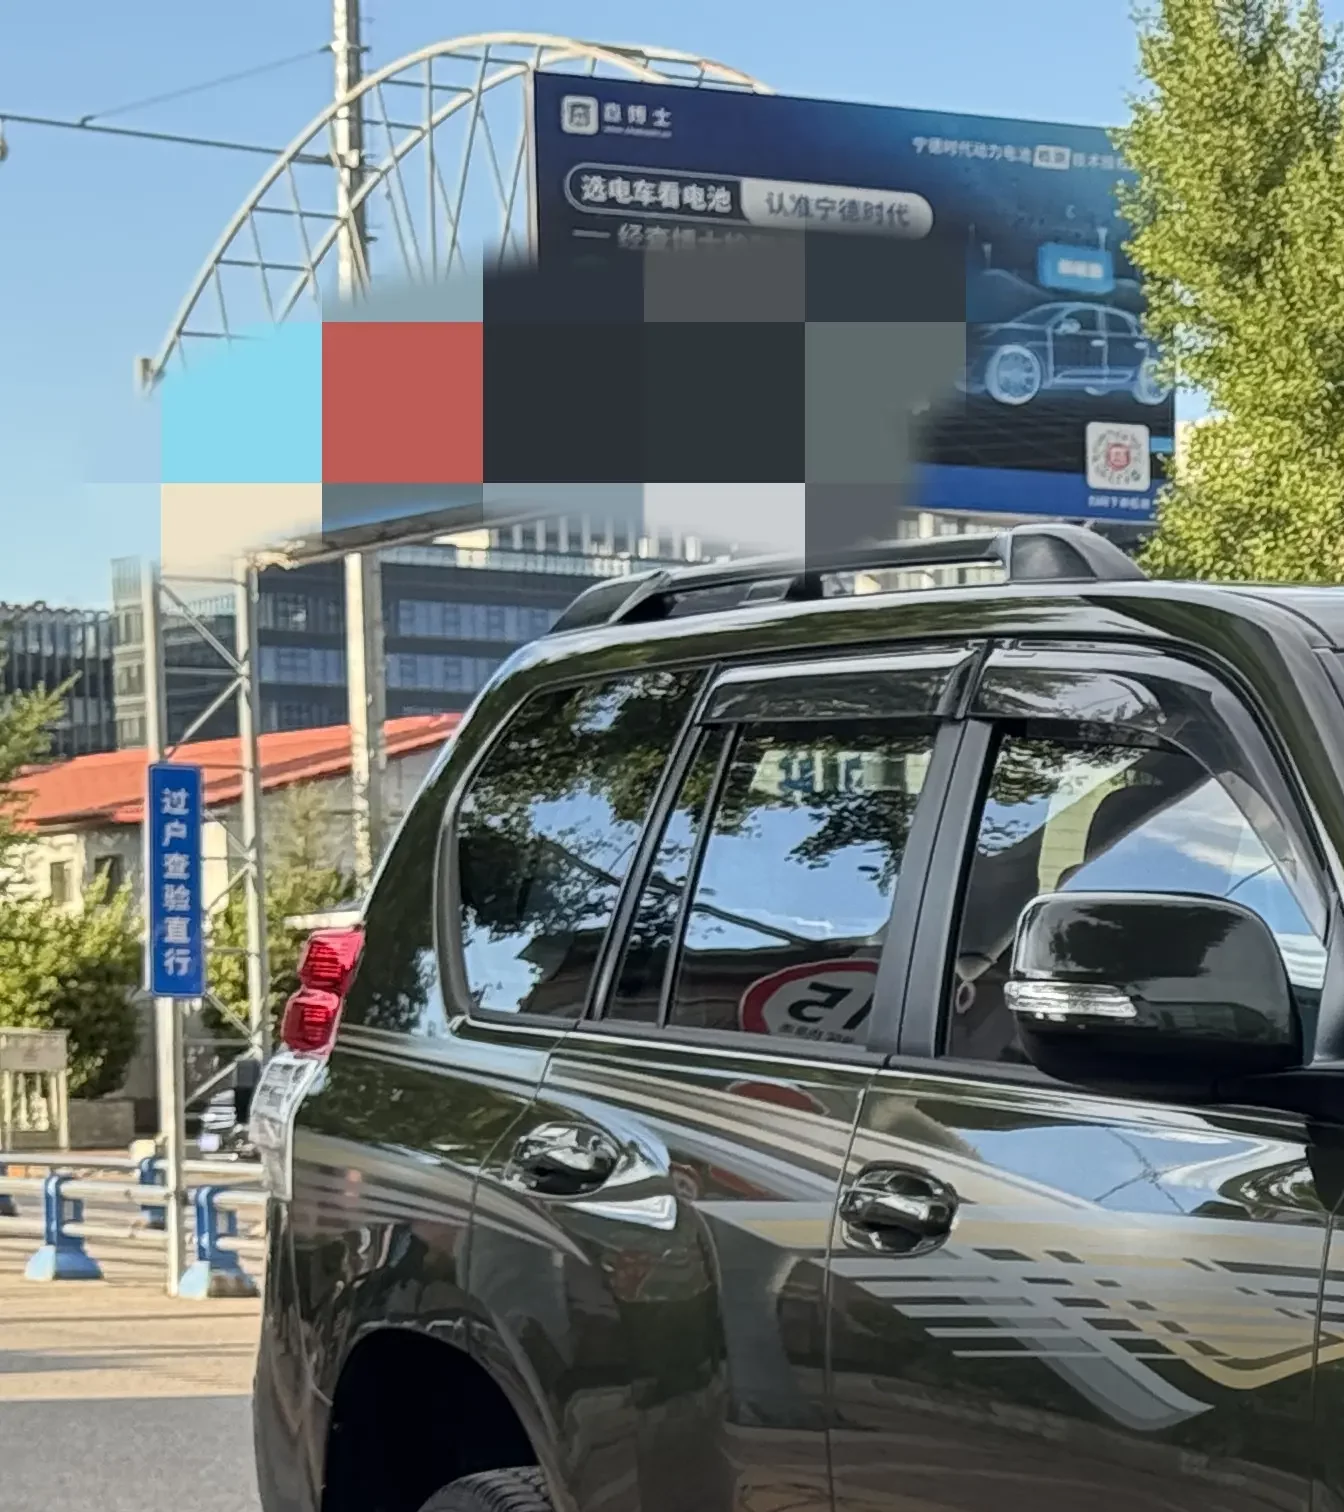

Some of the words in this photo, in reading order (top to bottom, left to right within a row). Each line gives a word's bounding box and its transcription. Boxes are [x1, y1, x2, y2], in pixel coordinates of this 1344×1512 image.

[580, 175, 732, 213] 选电车看电池
[766, 191, 911, 227] 认准宁德时代
[160, 787, 192, 977] 过户查验直行
